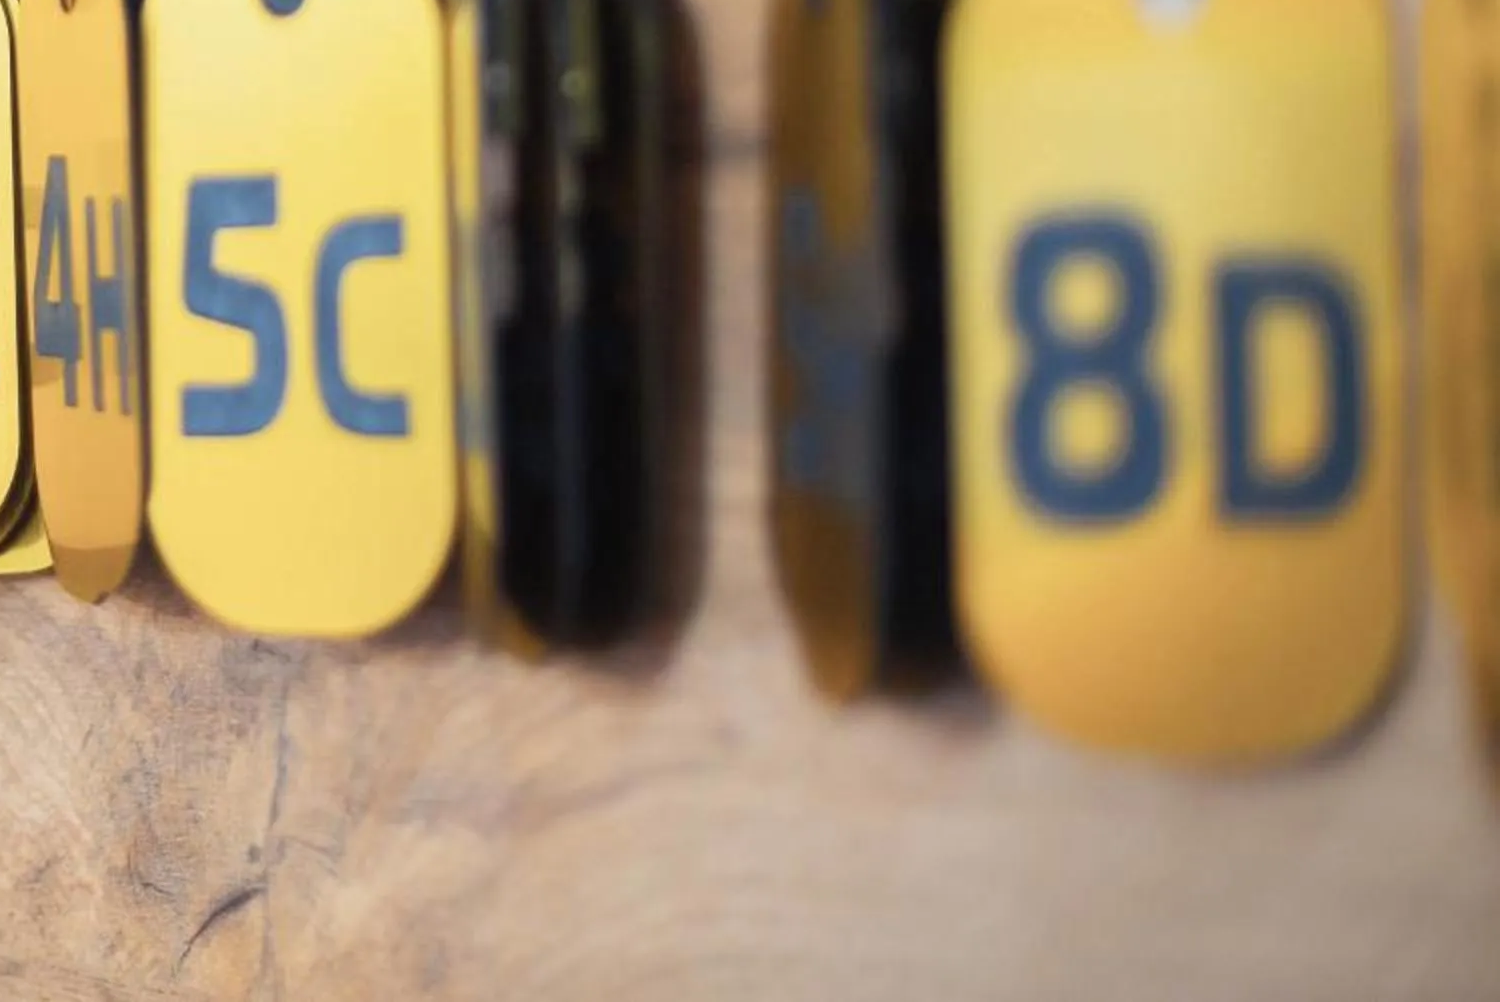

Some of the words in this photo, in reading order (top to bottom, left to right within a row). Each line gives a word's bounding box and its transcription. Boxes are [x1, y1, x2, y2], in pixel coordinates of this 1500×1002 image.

[33, 154, 132, 415] 4H
[180, 173, 412, 438] 5C
[1005, 208, 1372, 533] 8D
